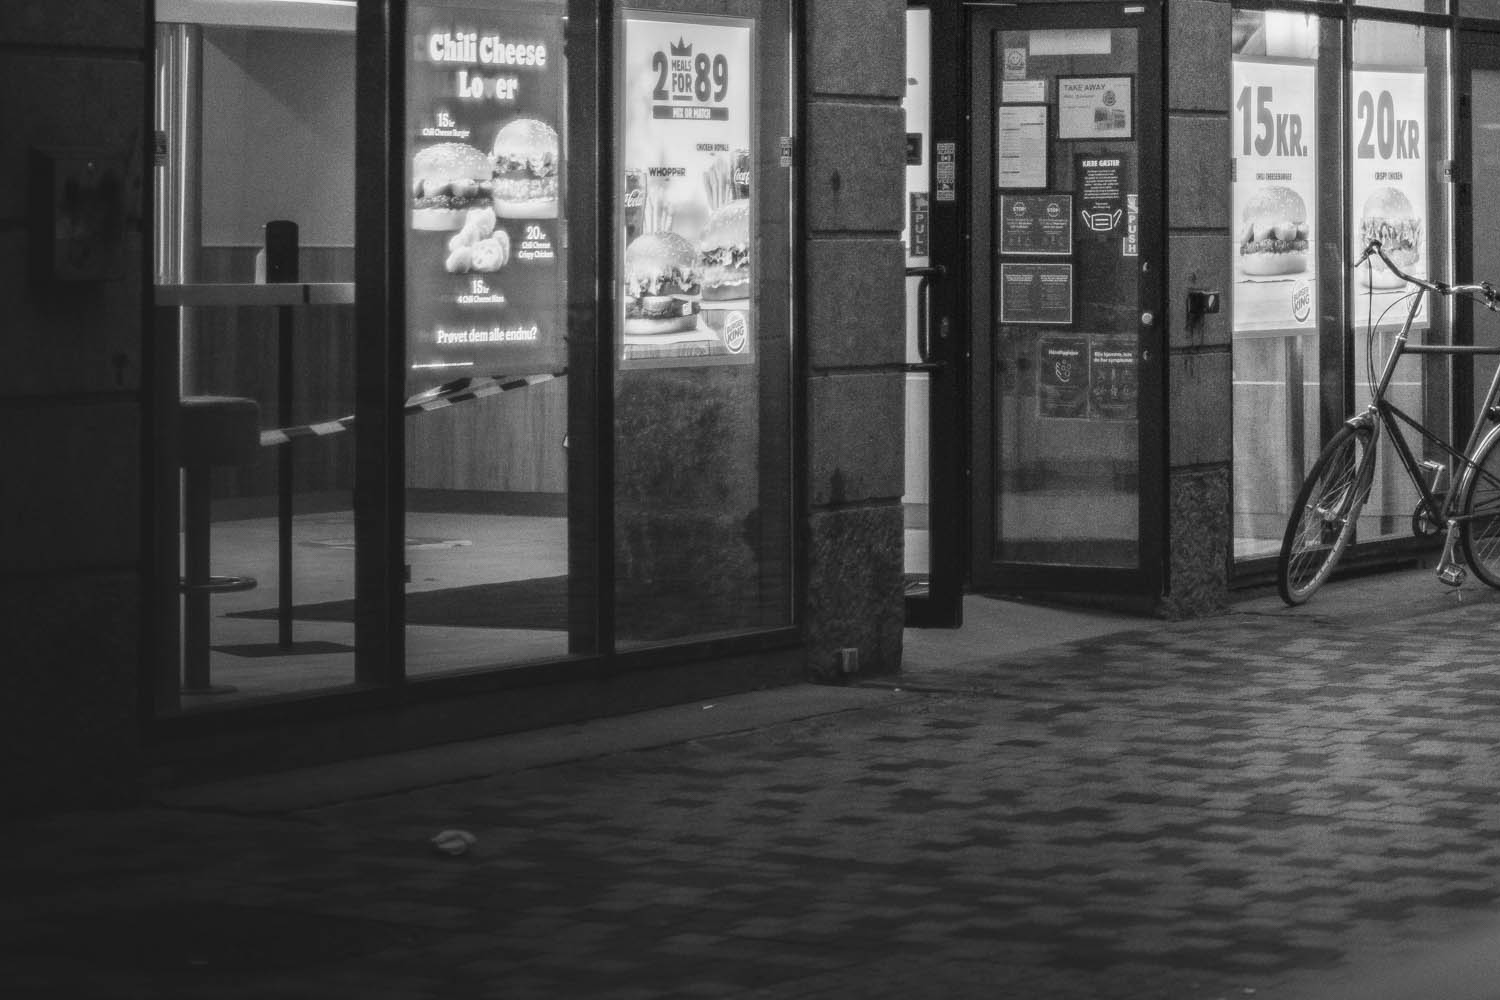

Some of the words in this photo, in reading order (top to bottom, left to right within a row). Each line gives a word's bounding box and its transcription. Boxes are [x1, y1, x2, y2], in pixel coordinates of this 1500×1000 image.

[430, 32, 477, 63] Chili
[480, 36, 546, 66] Cheese
[652, 51, 669, 101] 2
[671, 59, 692, 72] MEALS
[694, 53, 729, 102] 89
[459, 71, 518, 99] Lover
[672, 73, 692, 93] FOR
[1064, 84, 1083, 92] TAKE
[1084, 83, 1106, 91] AWAY
[648, 166, 686, 177] WHOPPER
[1128, 214, 1137, 254] PUSH
[437, 329, 467, 344] Prøvet
[468, 329, 488, 343] dem
[489, 328, 504, 342] alle
[505, 327, 537, 341] endnu?
